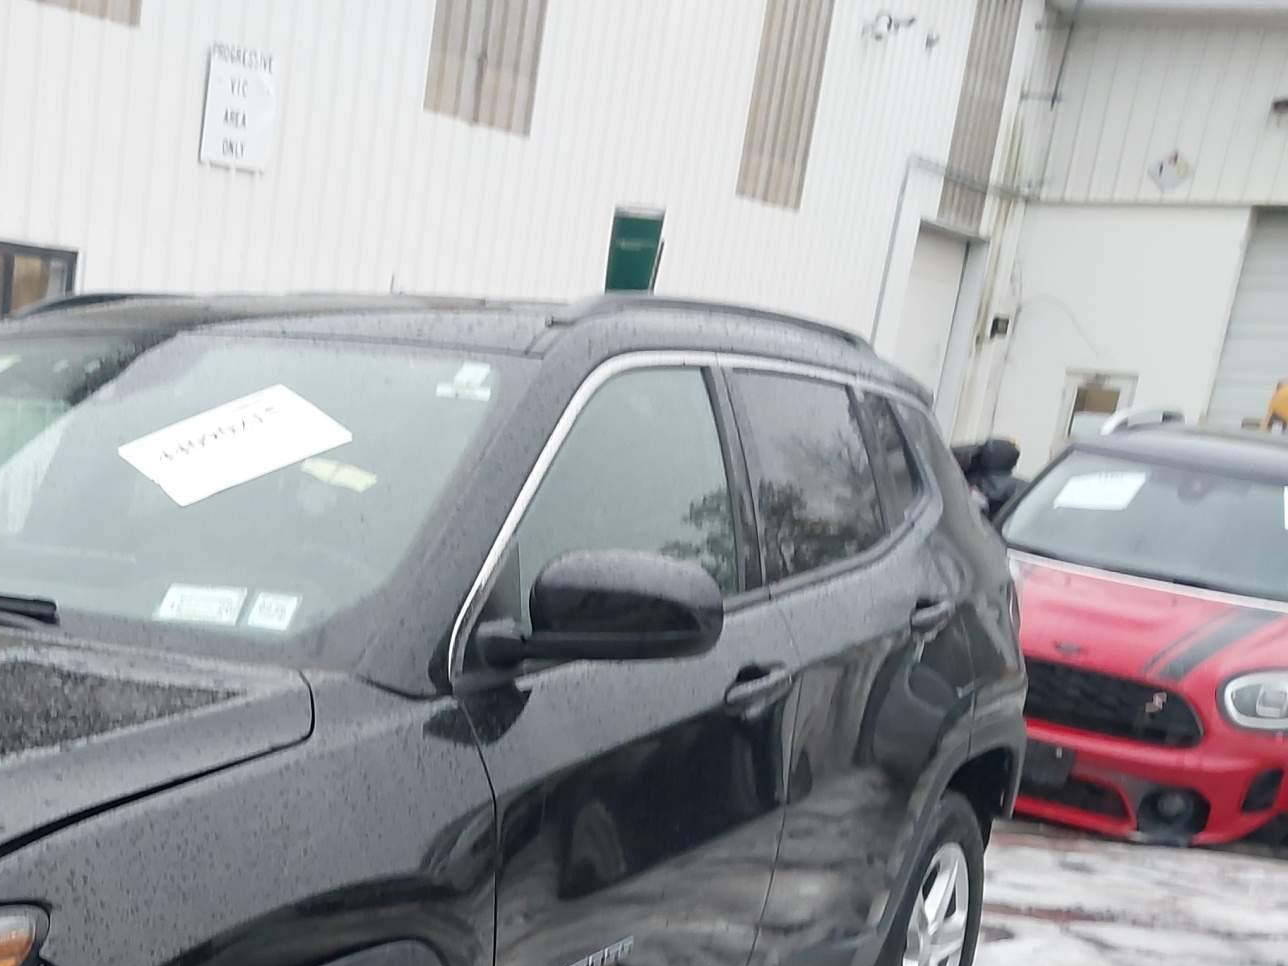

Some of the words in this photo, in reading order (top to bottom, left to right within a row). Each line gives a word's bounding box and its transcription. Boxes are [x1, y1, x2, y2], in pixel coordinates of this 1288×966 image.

[212, 41, 273, 74] PROGRESSIVE
[223, 107, 247, 129] AREA
[222, 137, 245, 159] ONLY
